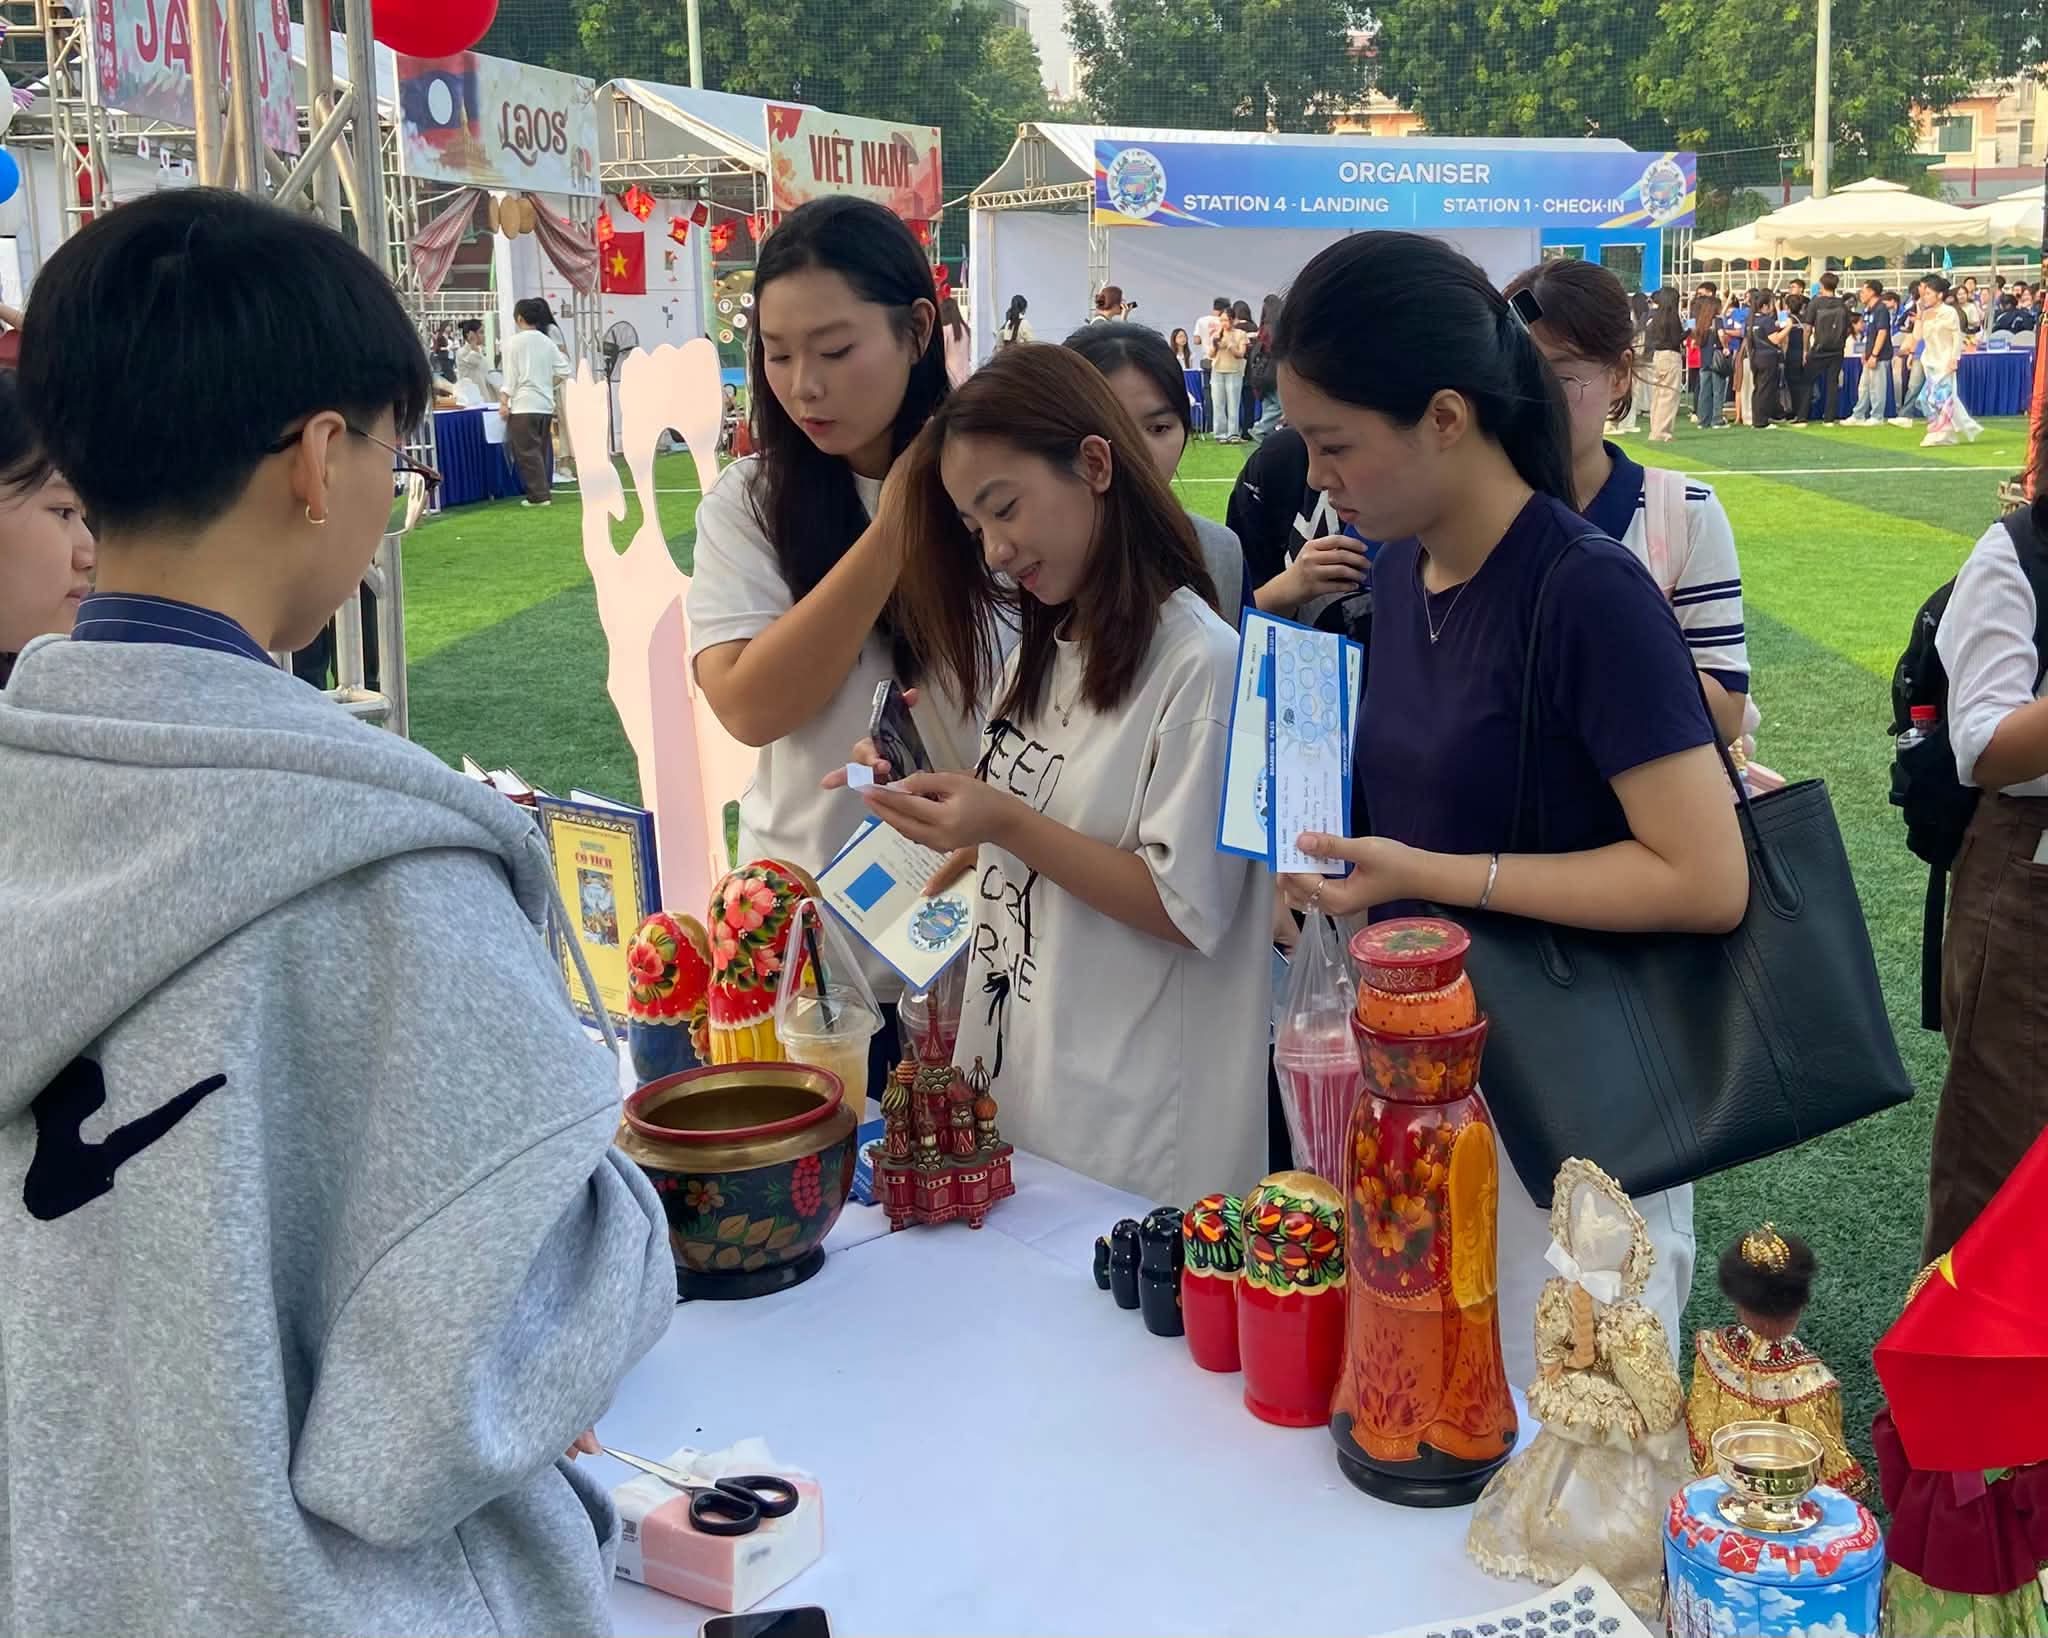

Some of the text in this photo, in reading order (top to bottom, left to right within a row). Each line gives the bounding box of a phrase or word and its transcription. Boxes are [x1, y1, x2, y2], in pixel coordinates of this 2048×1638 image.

[809, 128, 909, 190] VIỆT NAM
[1338, 161, 1490, 184] ORGANISER
[1183, 194, 1270, 212] STATION
[1274, 196, 1287, 212] 4
[1301, 197, 1389, 212] LANDING
[1443, 198, 1520, 213] STATION
[1524, 199, 1531, 213] 1
[1543, 198, 1624, 213] CHECK-IN
